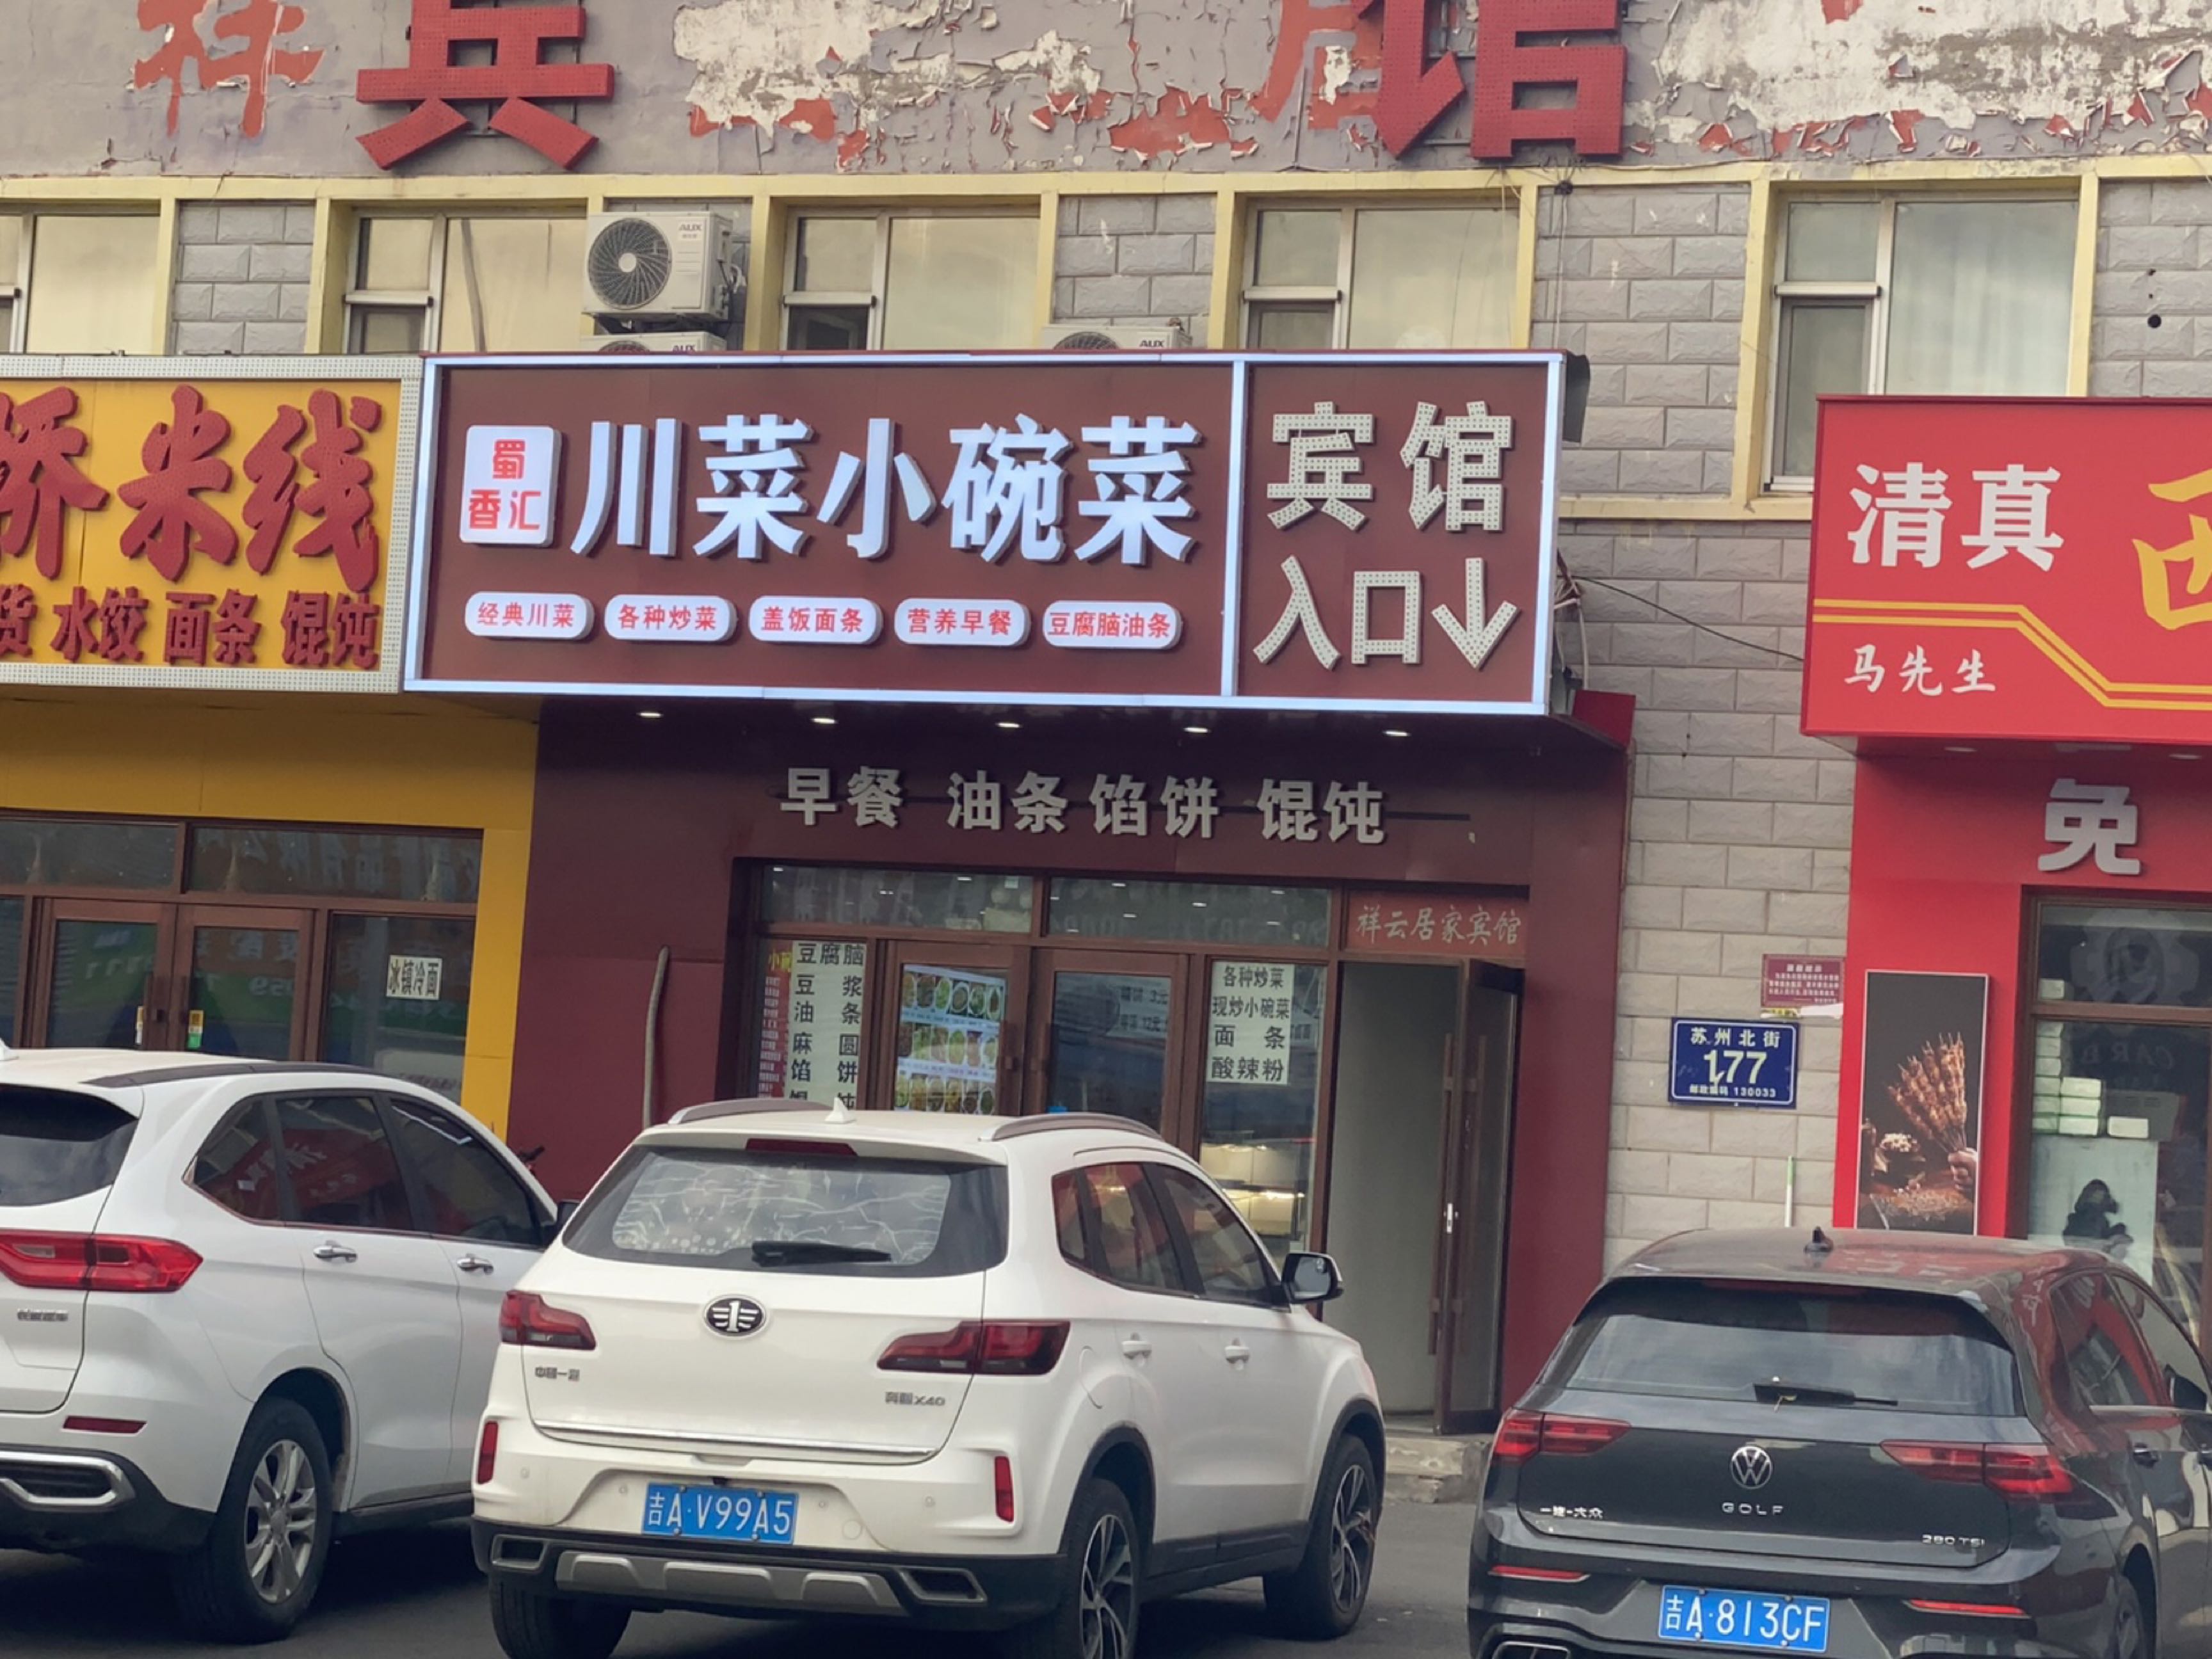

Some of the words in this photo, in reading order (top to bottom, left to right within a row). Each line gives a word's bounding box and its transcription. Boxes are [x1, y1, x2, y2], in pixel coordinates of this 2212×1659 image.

[492, 439, 525, 479] 蜀
[1267, 401, 1512, 531] 宾馆
[570, 414, 1201, 565] 川菜小碗菜
[469, 489, 541, 531] 香汇
[1847, 462, 2064, 572] 清真
[50, 586, 148, 663] 水饺
[163, 589, 262, 666] 面条
[281, 590, 381, 669] 馄饨
[477, 602, 575, 627] 经典川菜
[618, 604, 717, 631] 各种炒菜
[762, 606, 863, 633] 盖饭面条
[908, 609, 1011, 635] 营养早餐
[1049, 612, 1170, 637] 豆腐脑油条
[1253, 555, 1419, 669] 入口
[1845, 644, 1995, 695] 马先生
[780, 766, 903, 828] 早餐
[947, 770, 1068, 833] 油条
[1089, 774, 1219, 838] 馅饼
[1257, 778, 1385, 844] 馄饨
[2038, 778, 2141, 875] 免
[1356, 904, 1521, 945] 祥云居家宾馆
[797, 943, 863, 966] 豆腐脑
[1222, 966, 1285, 989] 各种炒菜
[1212, 996, 1290, 1018] 现炒小碗菜
[1691, 1027, 1780, 1048] 苏州北街
[1211, 1056, 1284, 1081] 酸辣粉
[1704, 1050, 1767, 1083] 177
[1722, 1502, 1783, 1515] GOLF
